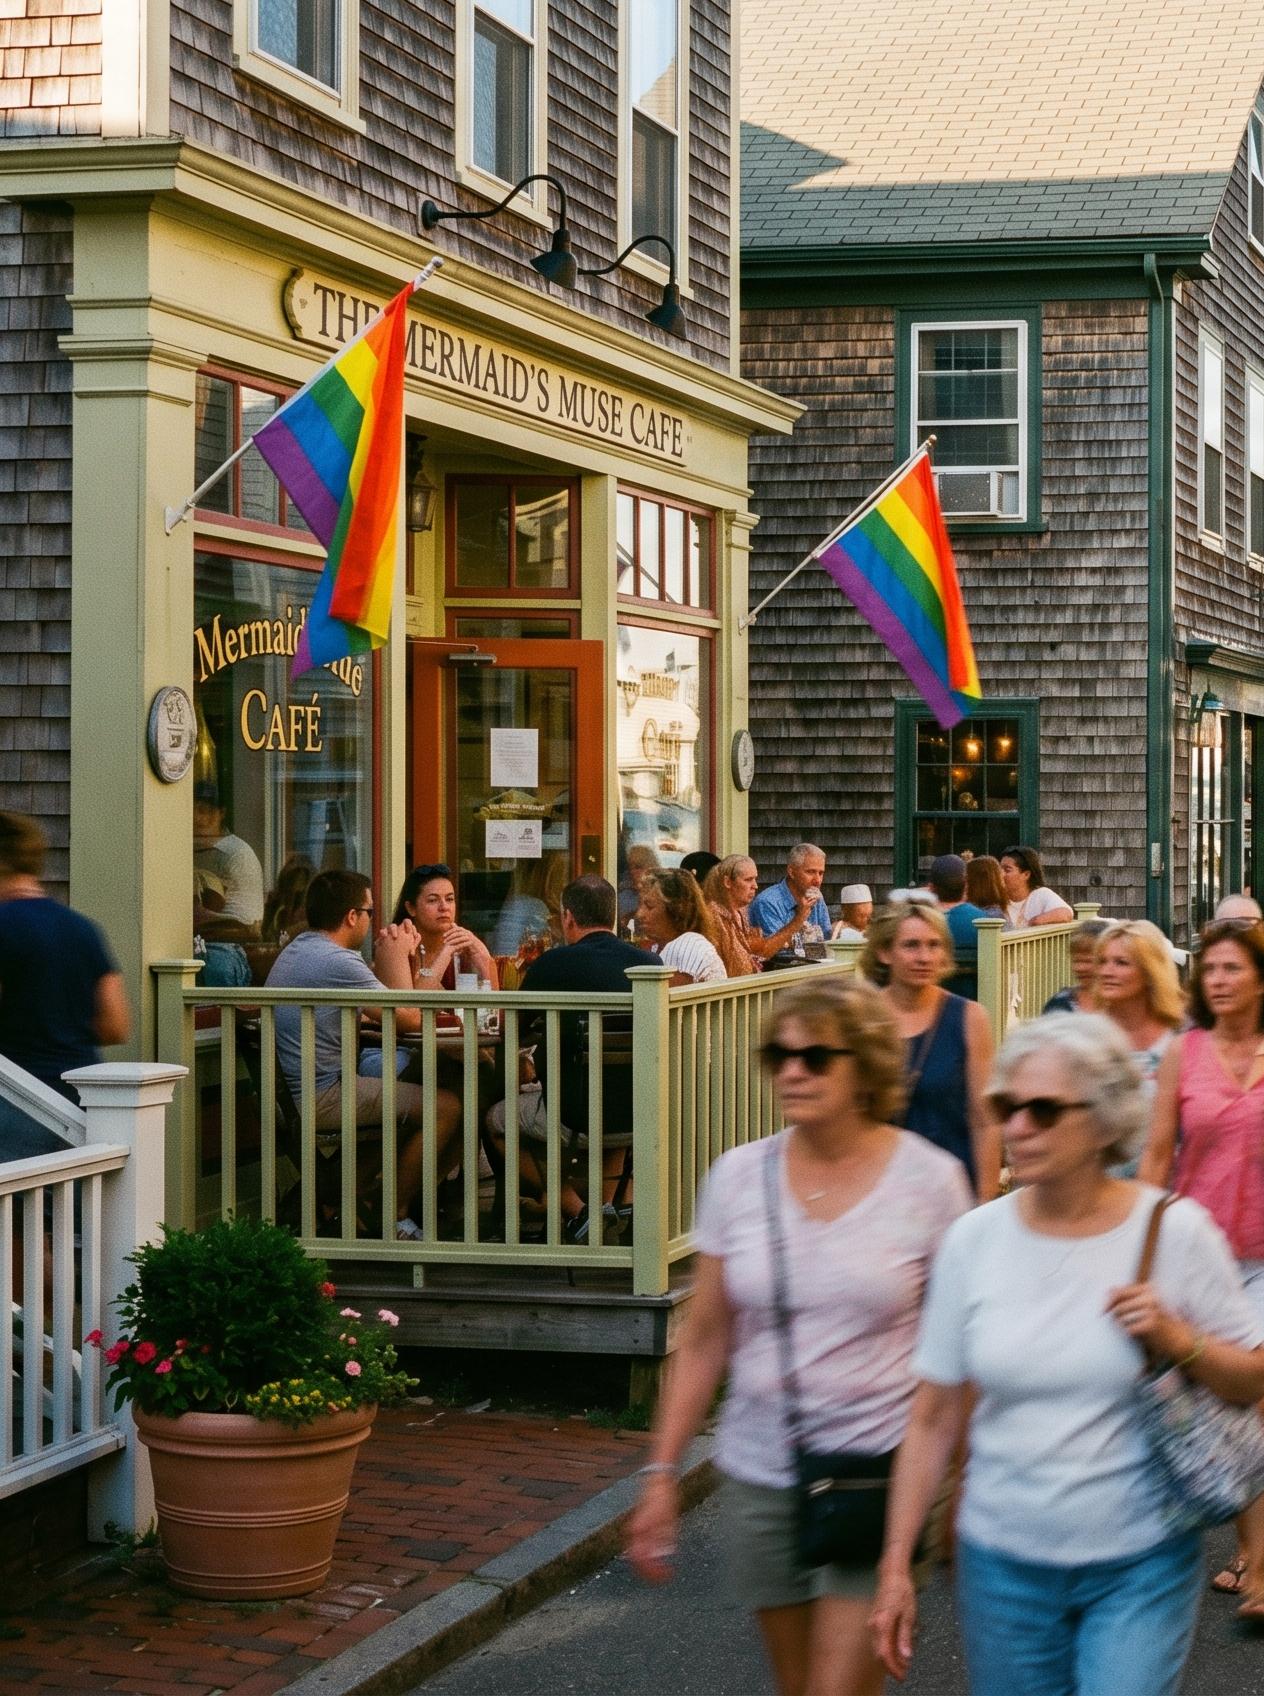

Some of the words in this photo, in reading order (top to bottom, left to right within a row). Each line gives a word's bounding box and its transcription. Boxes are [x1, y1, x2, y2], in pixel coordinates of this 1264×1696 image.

[558, 375, 623, 437] MUSE
[630, 403, 683, 457] CAFE
[241, 689, 322, 752] CAFÉ
